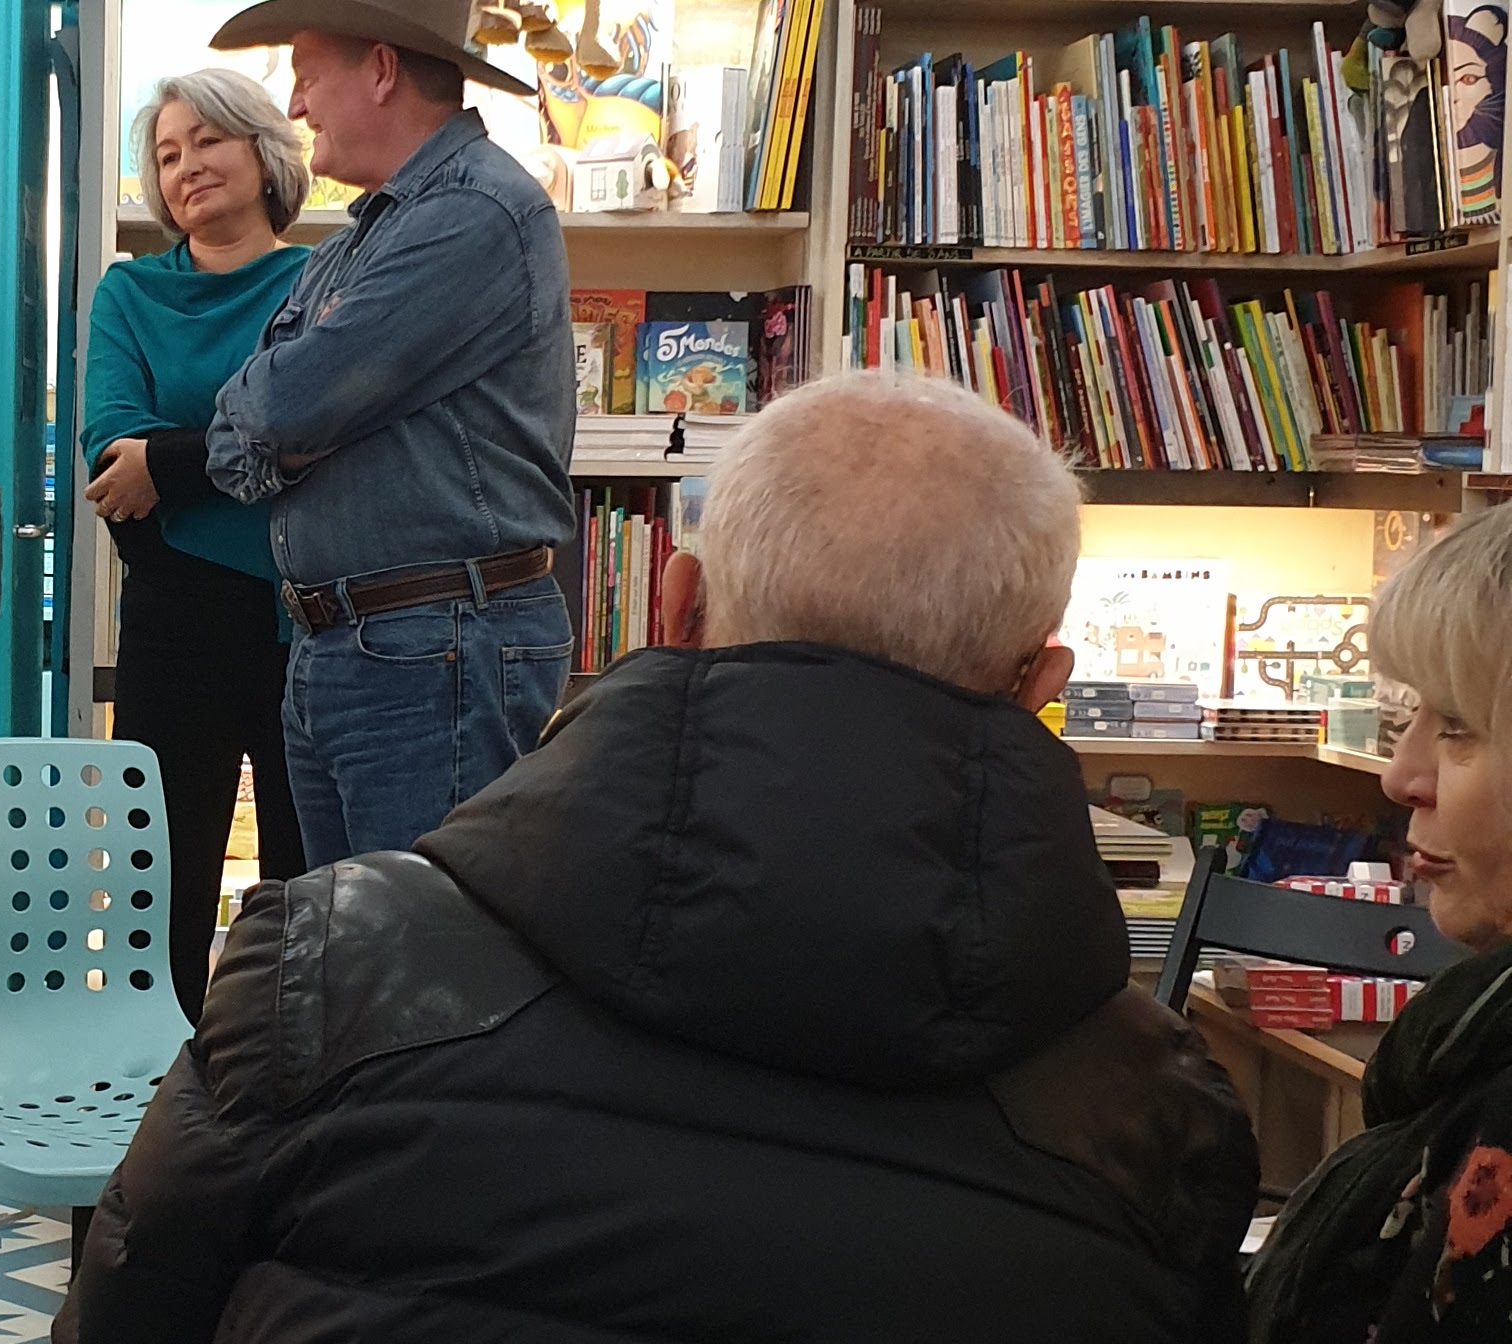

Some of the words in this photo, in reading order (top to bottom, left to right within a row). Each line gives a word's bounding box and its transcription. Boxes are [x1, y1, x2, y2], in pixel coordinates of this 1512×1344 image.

[576, 344, 587, 364] E
[656, 324, 690, 362] 5
[677, 333, 742, 358] Mondes
